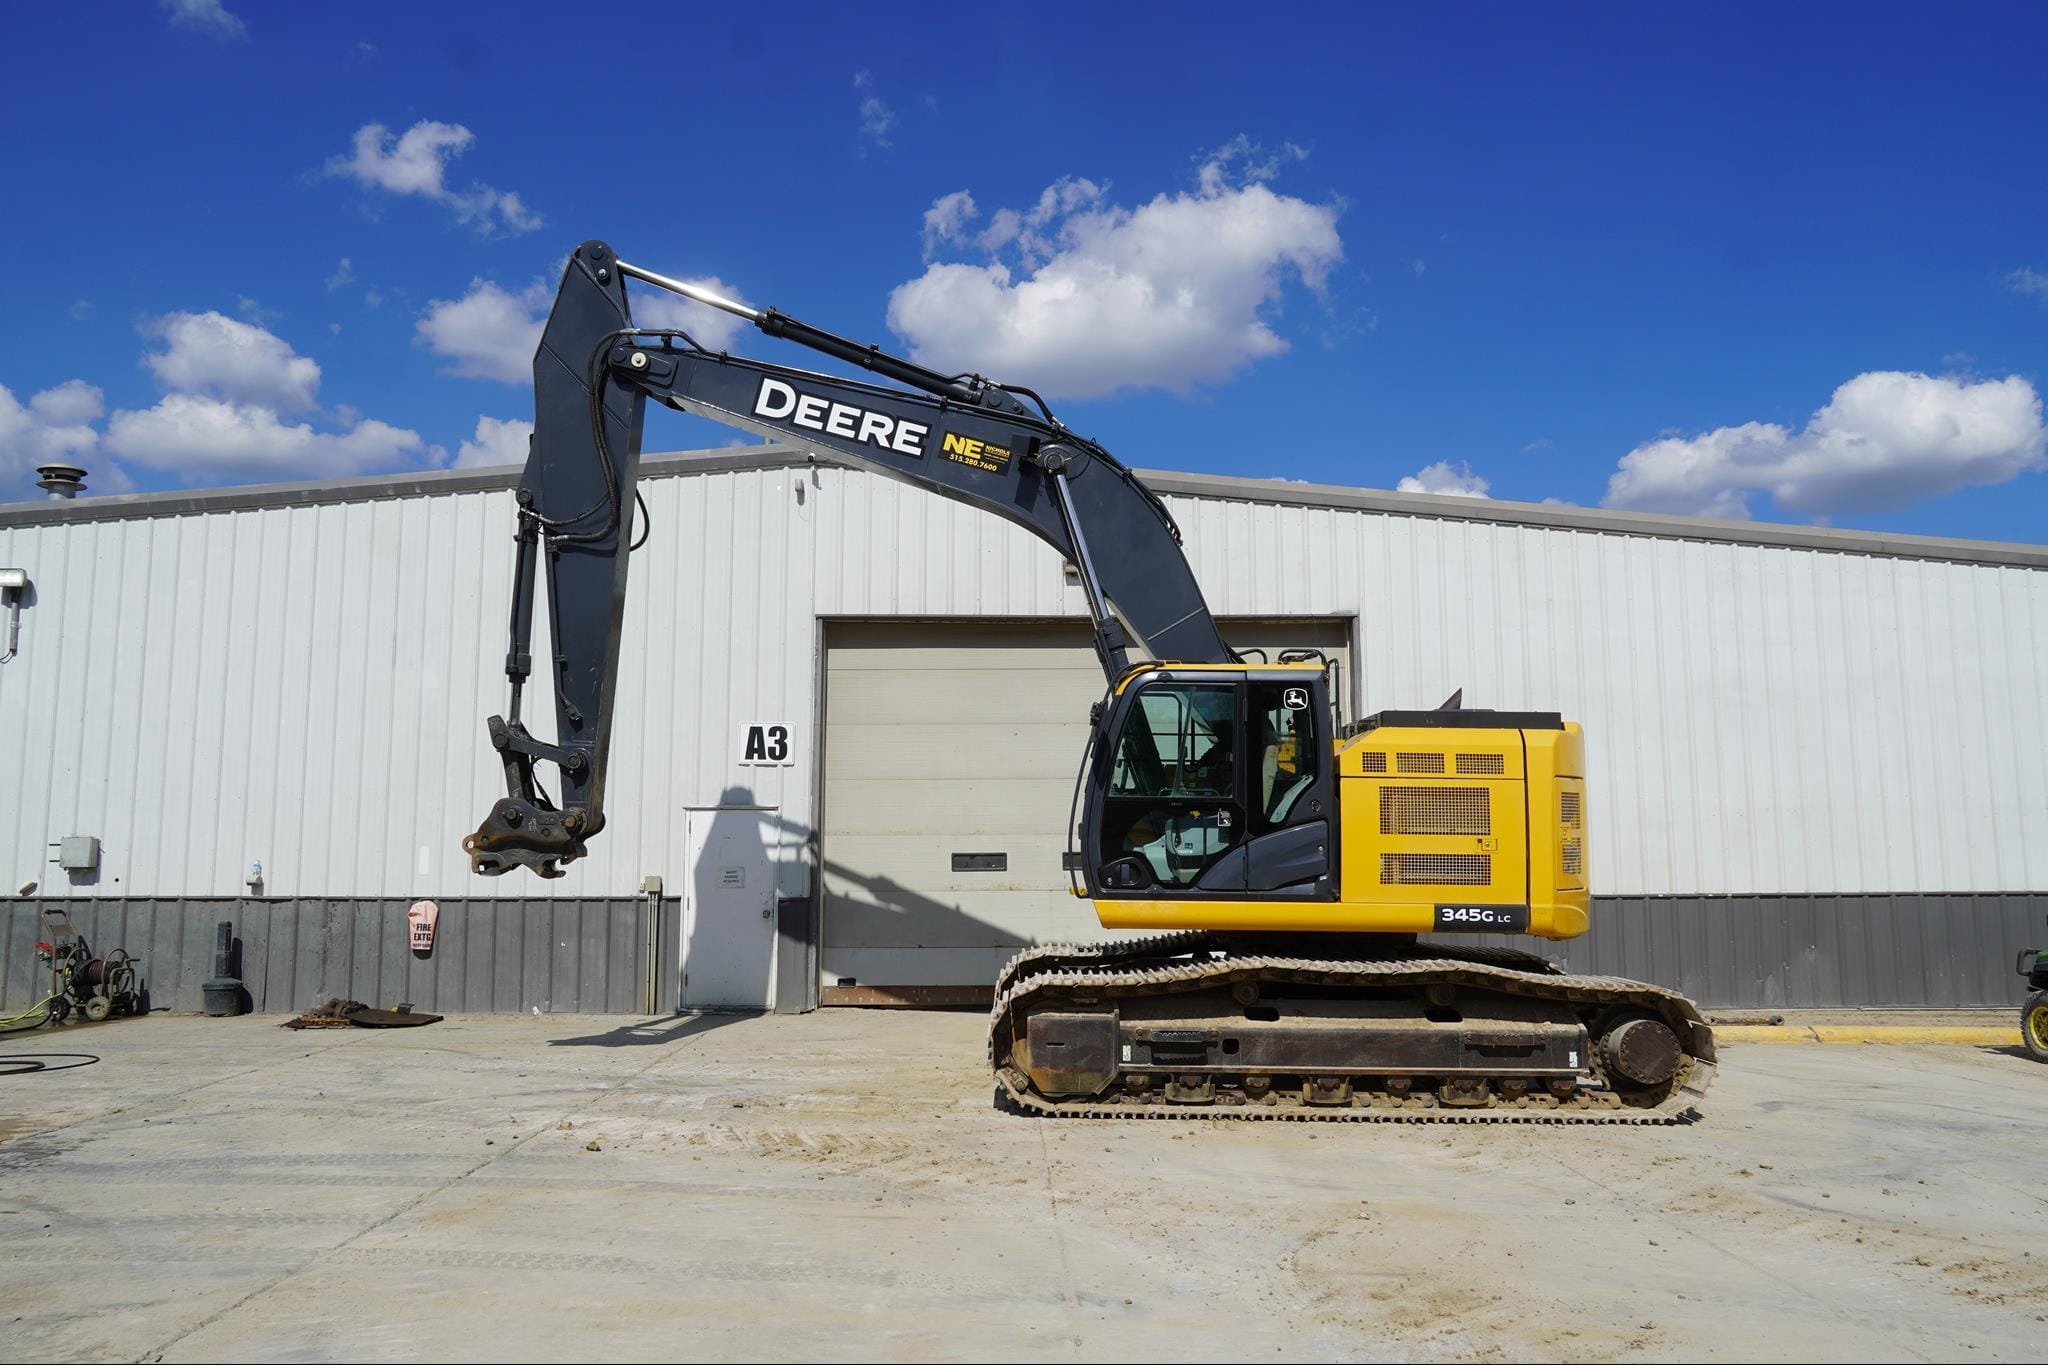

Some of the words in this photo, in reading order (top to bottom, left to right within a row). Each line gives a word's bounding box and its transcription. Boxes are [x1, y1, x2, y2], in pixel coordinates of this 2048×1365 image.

[754, 378, 928, 456] DEERE
[943, 433, 984, 459] NE
[949, 453, 998, 472] 515.280.7600
[744, 726, 788, 761] A3
[1441, 908, 1494, 922] 345G
[1497, 915, 1511, 923] LC
[416, 923, 432, 931] FIRE
